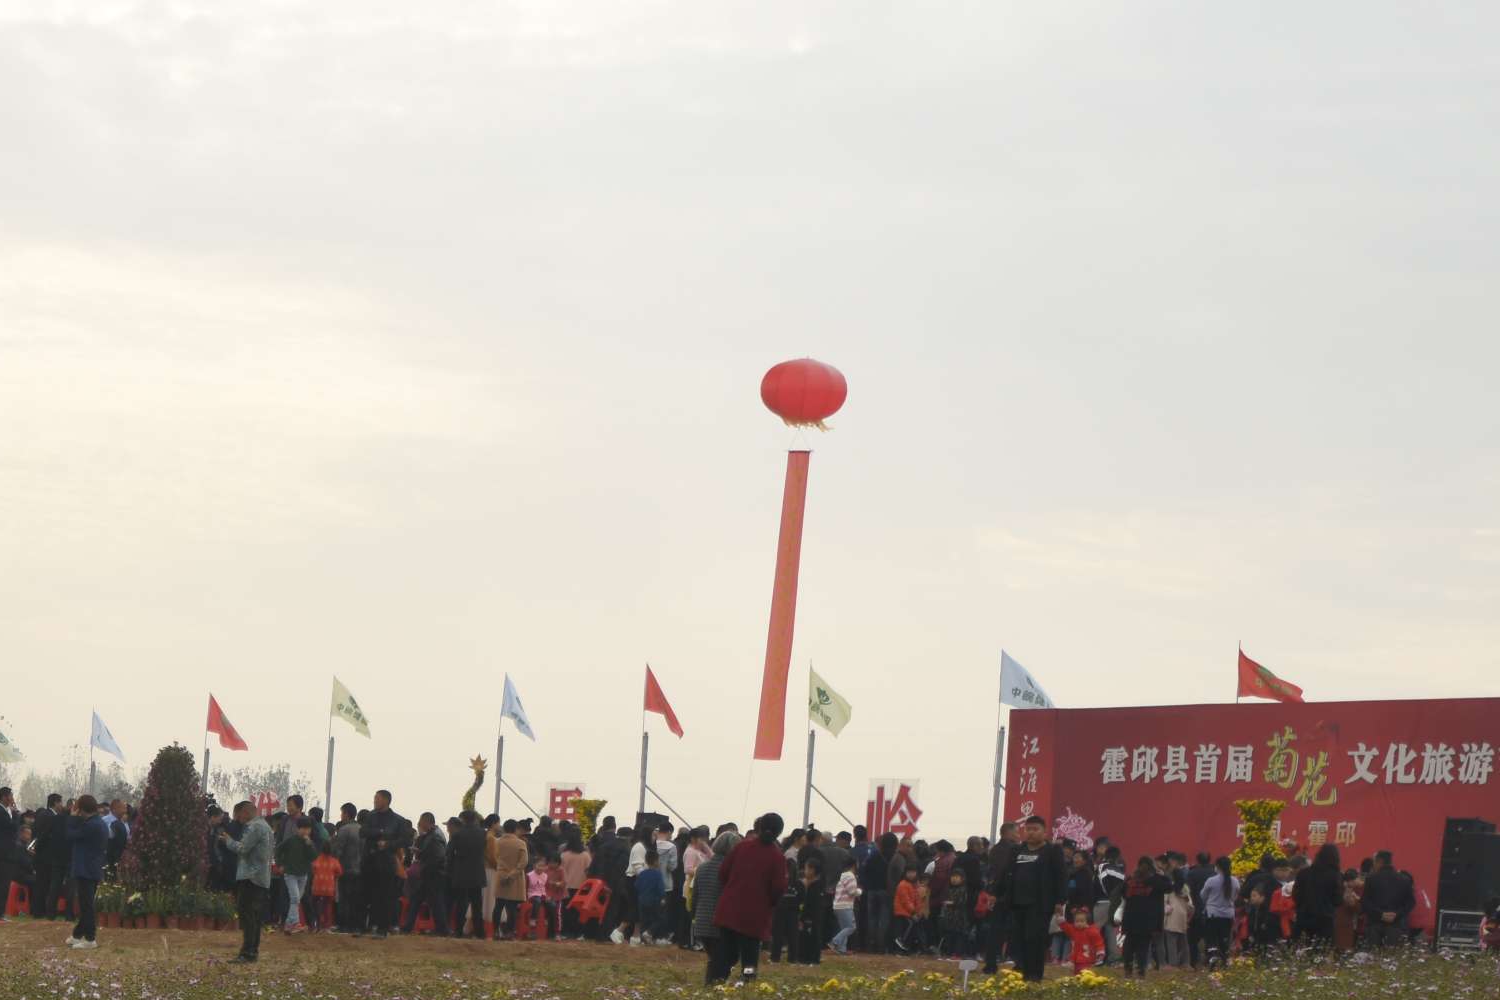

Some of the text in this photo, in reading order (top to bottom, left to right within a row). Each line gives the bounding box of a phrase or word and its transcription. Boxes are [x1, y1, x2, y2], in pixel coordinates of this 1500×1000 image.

[1100, 725, 1495, 807] 霍邱县首届 菊花 文化旅游
[866, 783, 924, 843] 岭
